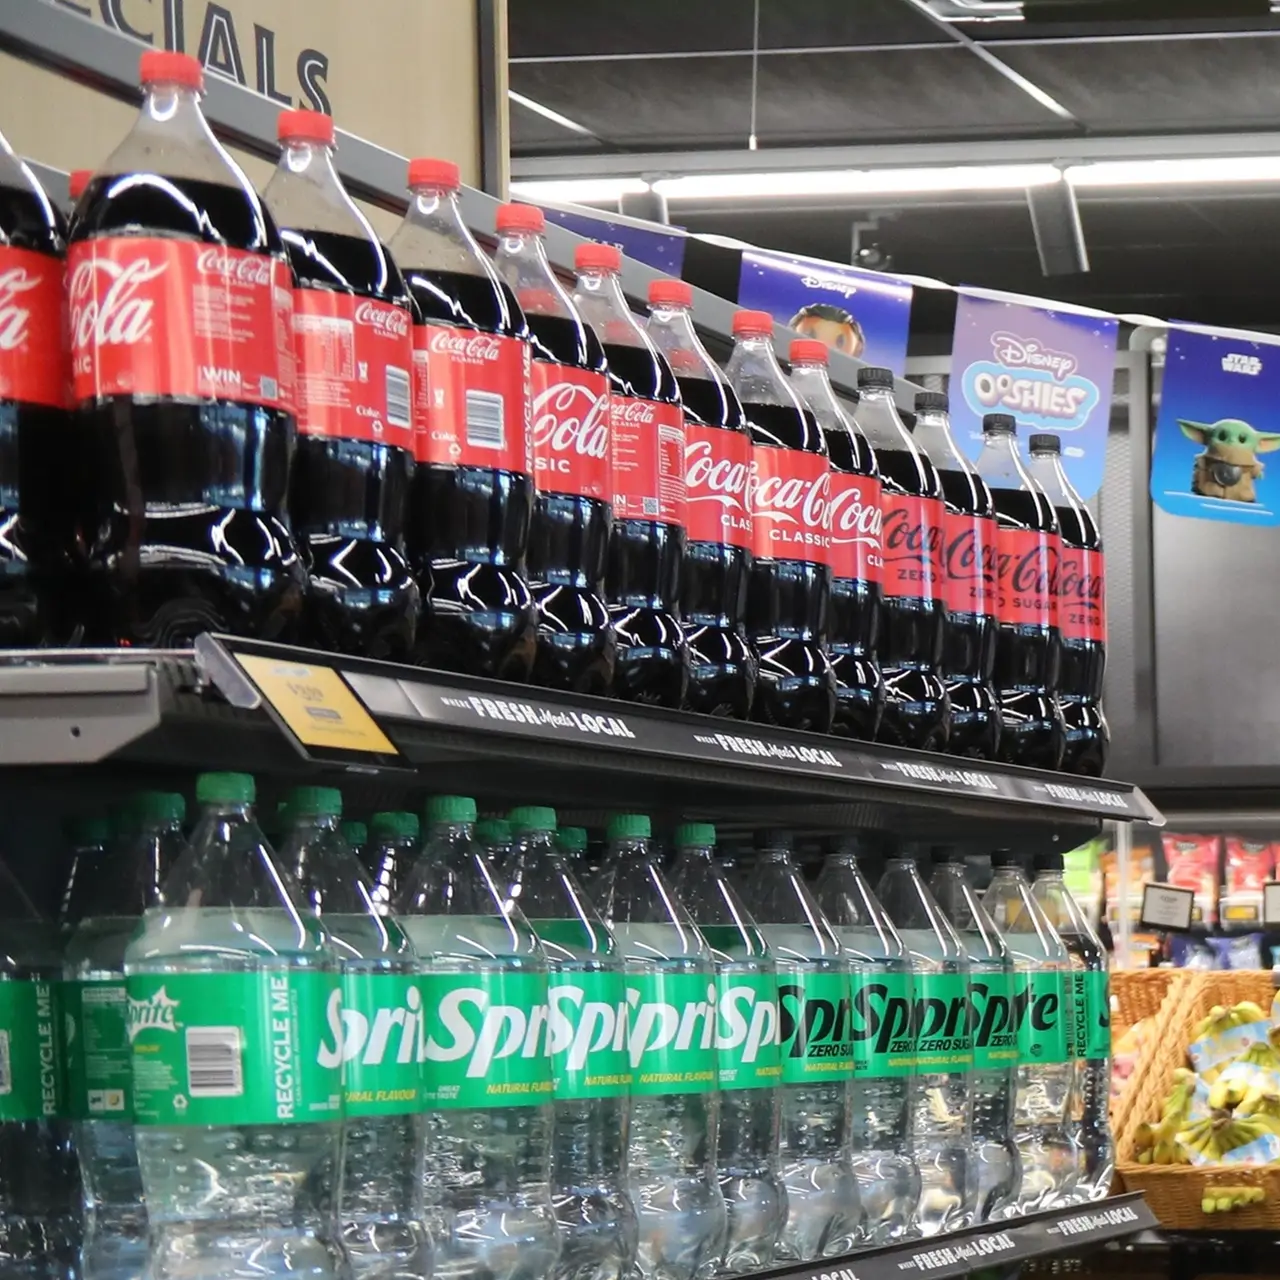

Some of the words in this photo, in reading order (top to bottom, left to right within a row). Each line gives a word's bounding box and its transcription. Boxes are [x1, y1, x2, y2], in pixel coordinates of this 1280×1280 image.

[74, 0, 333, 117] CIALS
[197, 249, 271, 286] Coca-Cola
[355, 301, 409, 337] Coca-Cola
[430, 330, 501, 360] Coca-Cola
[521, 344, 533, 377] ME
[1221, 353, 1263, 365] STAR
[202, 366, 242, 382] WIN
[1221, 363, 1263, 376] WARS
[523, 380, 534, 474] RECYCLE
[769, 529, 831, 549] CLASSIC
[468, 695, 540, 726] FRESH
[570, 709, 636, 739] LOCAL
[715, 735, 768, 760] FRESH
[794, 744, 842, 768] LOCAL
[897, 761, 938, 784] FRESH
[958, 769, 999, 791] LOCAL
[1045, 783, 1083, 803] FRESH
[1095, 788, 1129, 808] LOCAL
[36, 985, 50, 1017] ME
[270, 976, 290, 1015] ME
[1075, 974, 1085, 1001] ME
[918, 1039, 951, 1052] ZERO
[1077, 1002, 1088, 1058] RECYCLE
[807, 1043, 841, 1058] ZERO
[38, 1021, 57, 1116] RECYCLE
[273, 1019, 294, 1119] RECYCLE
[639, 1072, 676, 1084] NATURAL
[486, 1082, 529, 1095] NATURAL
[1057, 1215, 1094, 1237] FRESH
[1104, 1205, 1138, 1226] LOCAL
[912, 1247, 955, 1271] FRESH
[974, 1233, 1016, 1257] LOCAL
